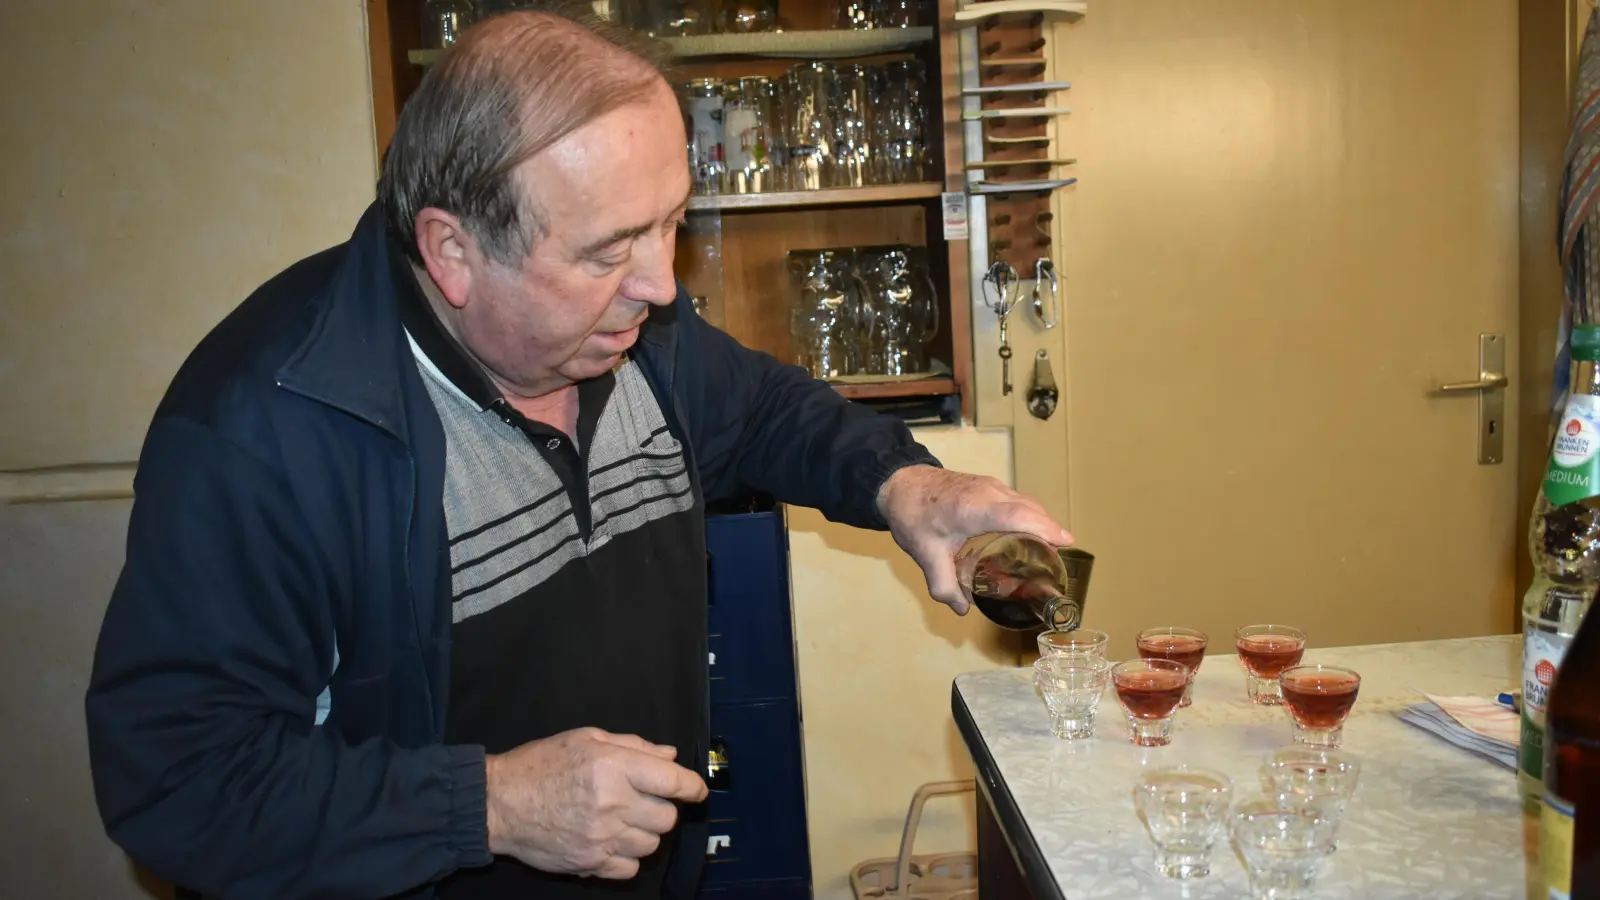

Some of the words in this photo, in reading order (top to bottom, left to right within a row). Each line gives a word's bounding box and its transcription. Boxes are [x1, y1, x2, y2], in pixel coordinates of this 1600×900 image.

[1558, 436, 1589, 446] FRANKEN
[1556, 443, 1588, 453] BRUNNEN
[1547, 469, 1589, 487] MEDIUM
[1525, 680, 1548, 696] FRAN
